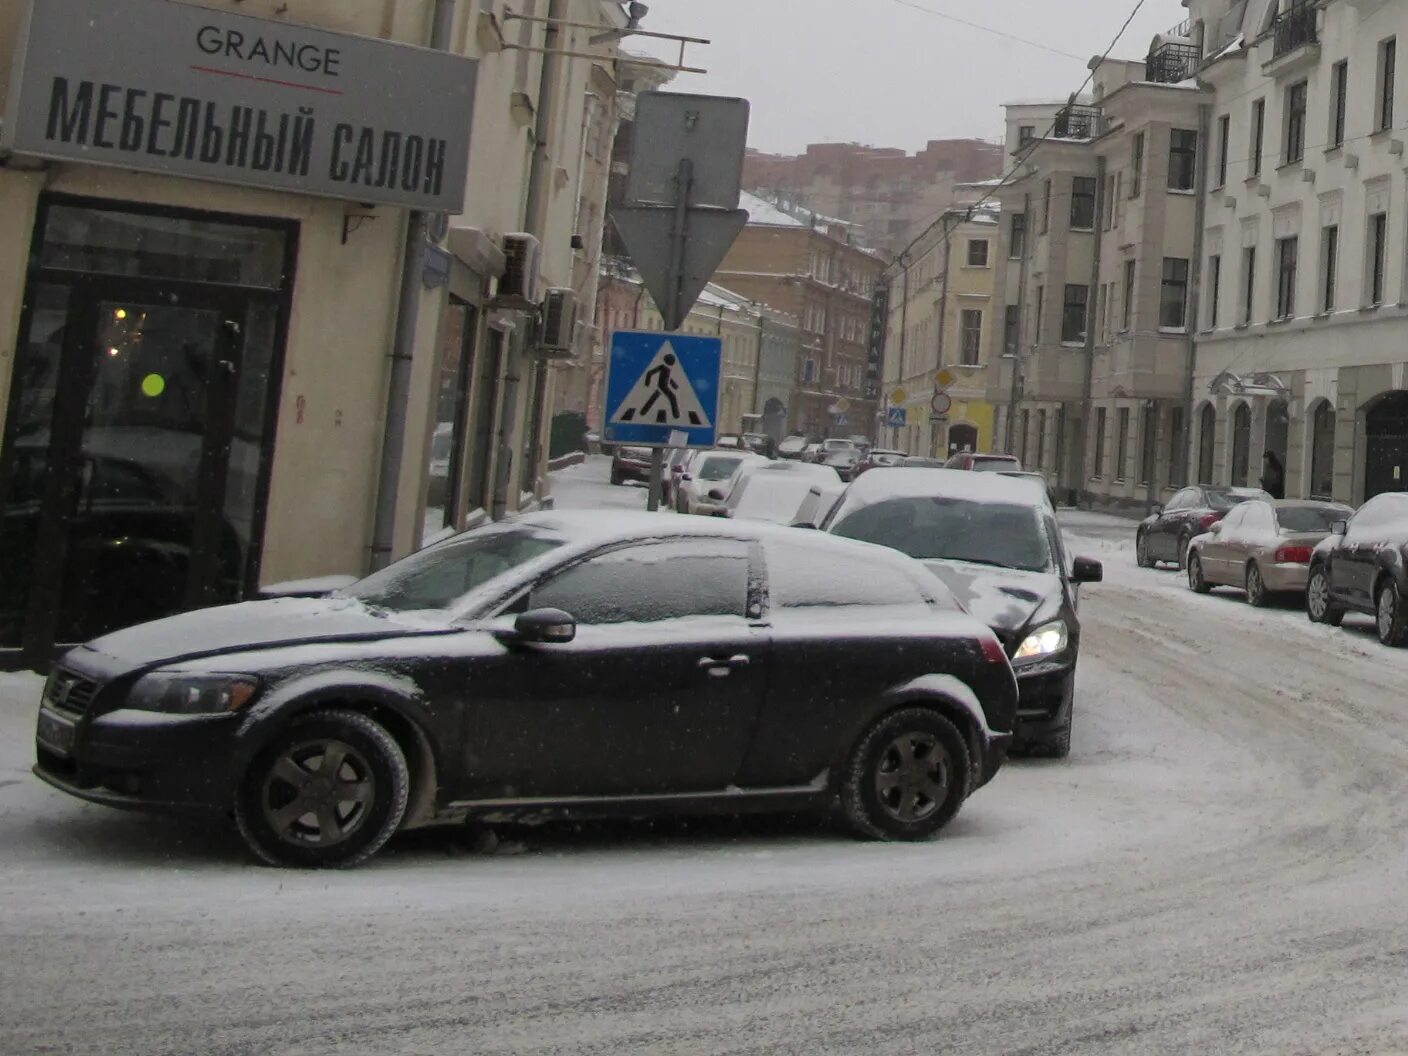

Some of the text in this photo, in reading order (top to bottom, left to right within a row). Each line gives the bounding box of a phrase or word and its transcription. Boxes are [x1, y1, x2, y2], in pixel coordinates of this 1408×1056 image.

[196, 26, 341, 76] GRANGE
[45, 76, 447, 195] МЕБЕЛЬНЫЙ САЛОН
